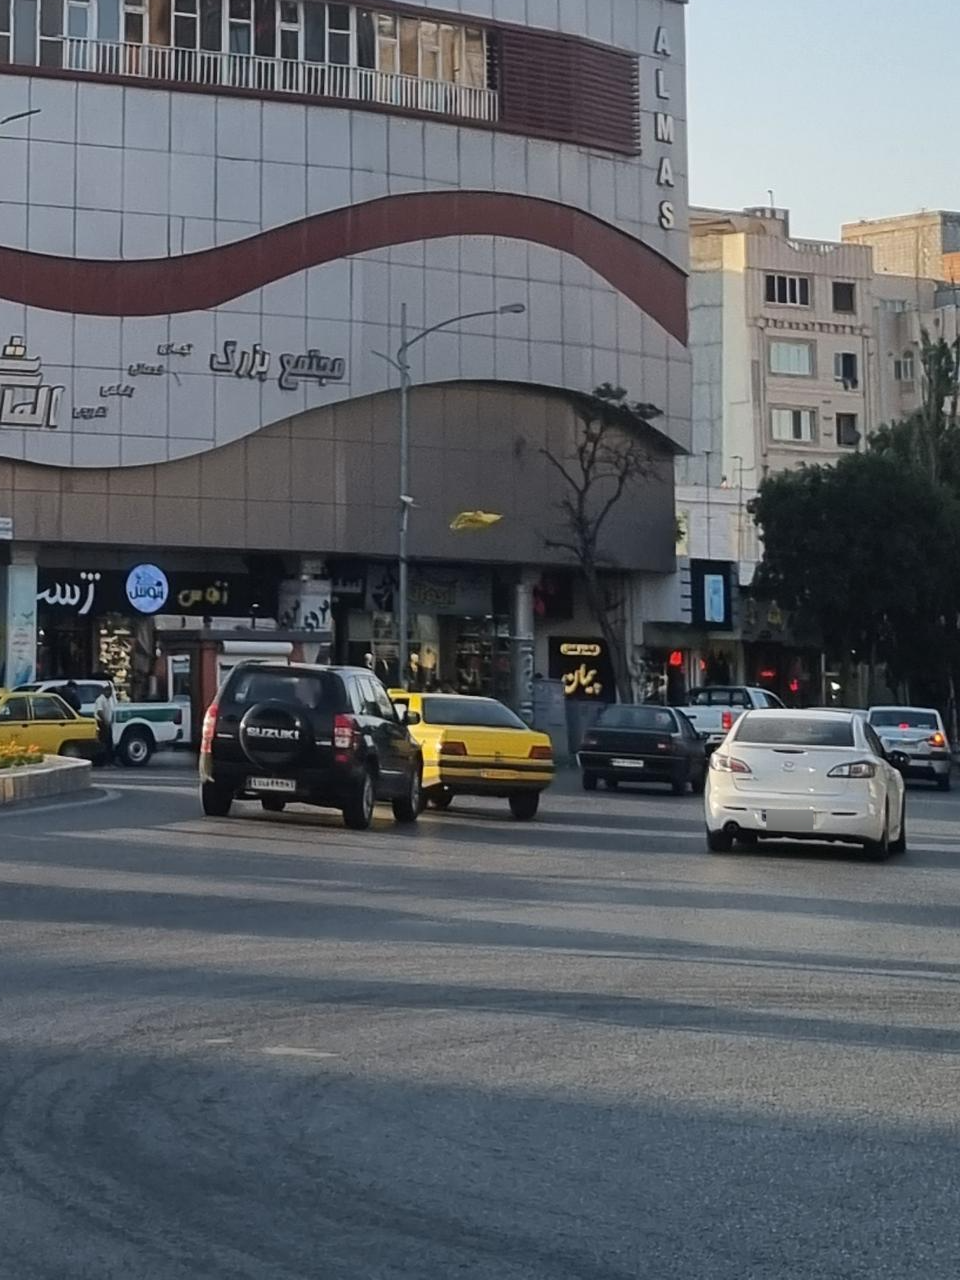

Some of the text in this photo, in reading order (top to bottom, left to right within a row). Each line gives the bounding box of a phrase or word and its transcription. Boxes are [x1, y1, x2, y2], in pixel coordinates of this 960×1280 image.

[653, 25, 675, 231] ALMAS
[209, 340, 345, 391] مجتمع بزرگ
[246, 726, 300, 741] SUZUKI
